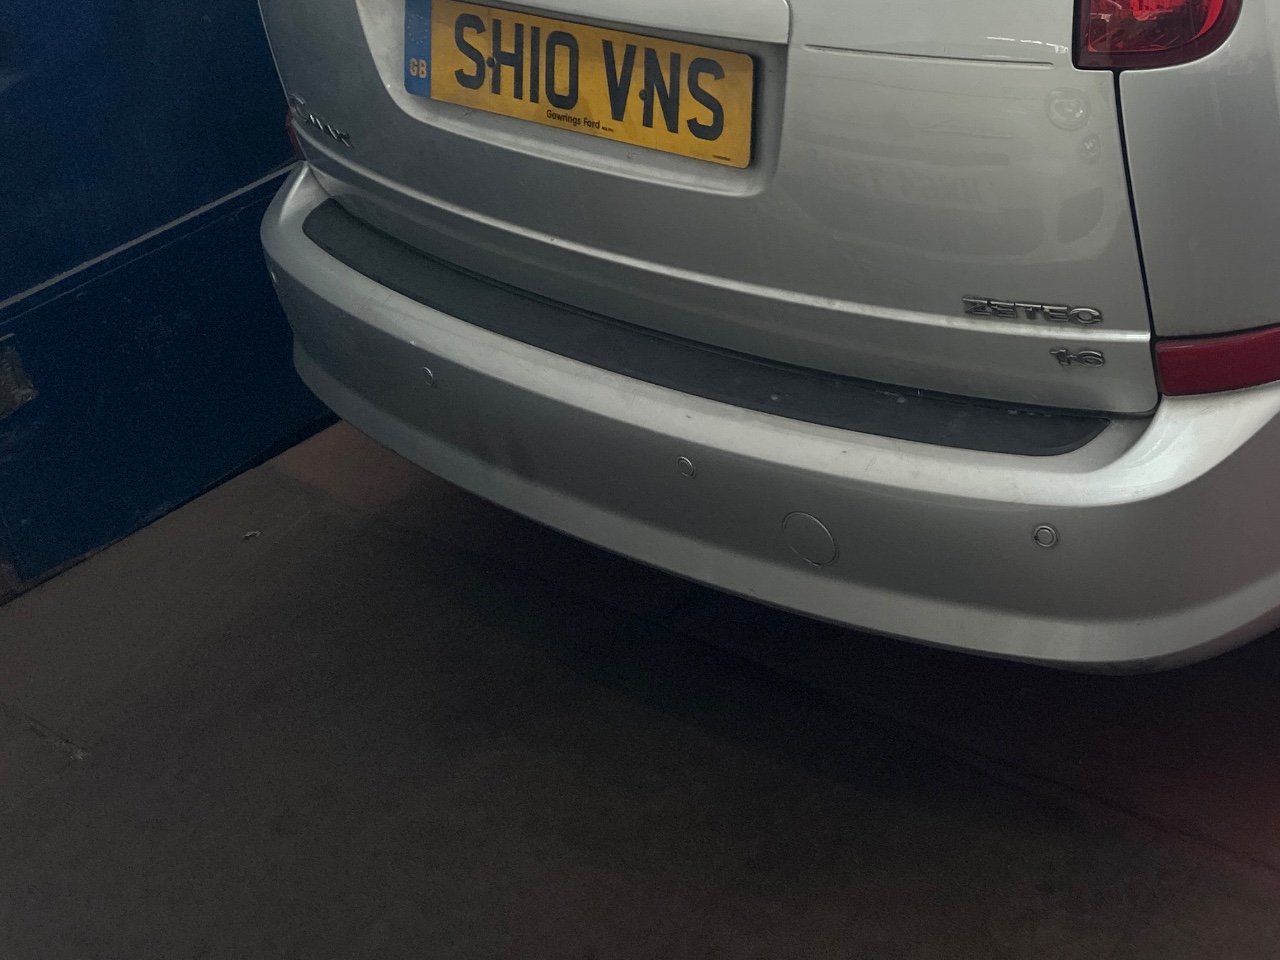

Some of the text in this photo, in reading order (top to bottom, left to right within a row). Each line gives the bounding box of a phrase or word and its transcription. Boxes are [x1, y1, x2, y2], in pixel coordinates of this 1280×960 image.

[409, 57, 427, 79] GB
[454, 13, 725, 141] SH10 VNS
[583, 117, 601, 129] Ford
[962, 295, 1103, 325] ZETEC
